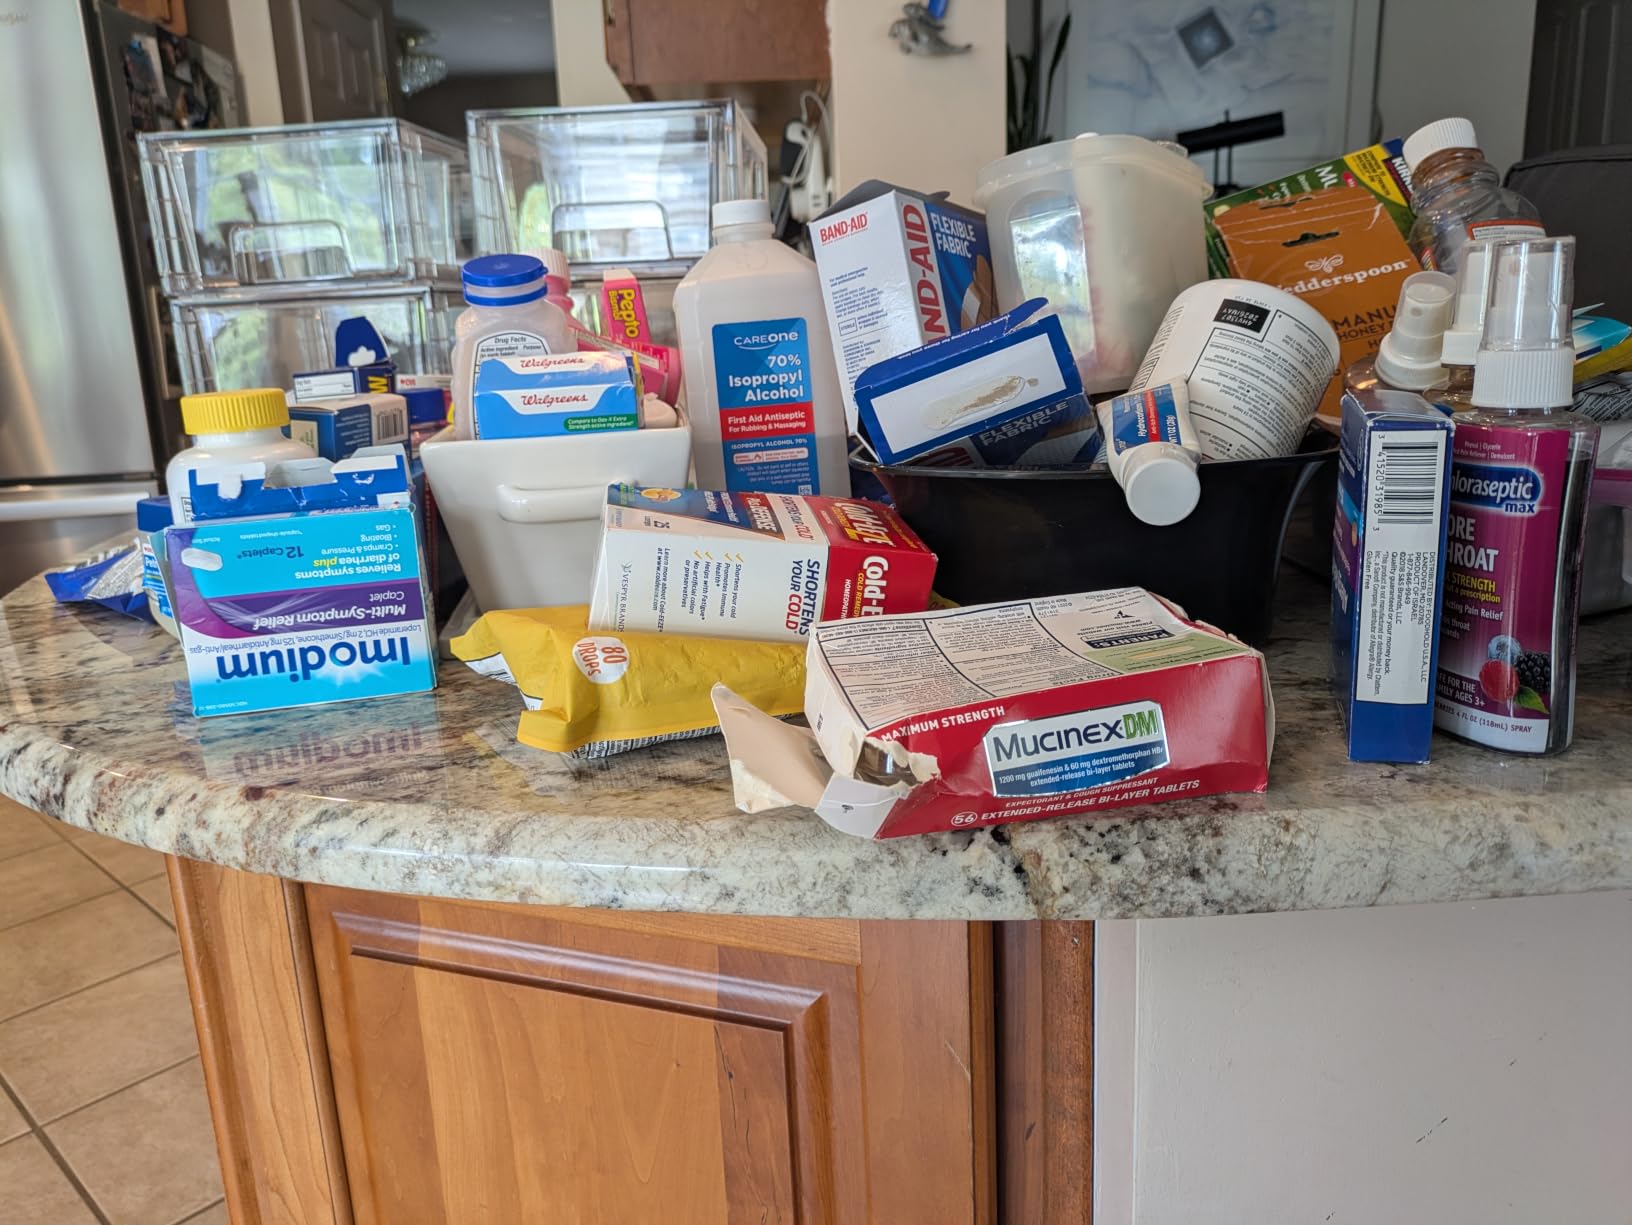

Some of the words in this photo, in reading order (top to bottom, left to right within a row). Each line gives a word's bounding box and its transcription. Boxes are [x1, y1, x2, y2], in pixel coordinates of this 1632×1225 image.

[820, 212, 868, 243] BAND-AID
[930, 213, 977, 242] FLEXIBLE
[933, 234, 972, 258] FABRIC
[619, 288, 640, 338] Pepto
[494, 336, 508, 344] Drug
[520, 357, 584, 370] Walgreens
[768, 354, 801, 368] 70%
[729, 368, 803, 388] Isopropyl
[521, 394, 588, 408] Walgreens
[745, 384, 803, 402] Alcohol
[568, 418, 590, 426] Compare
[568, 422, 590, 430] Strength
[728, 414, 746, 425] First
[748, 413, 762, 423] Aid
[764, 410, 806, 421] Antiseptic
[741, 424, 768, 433] Rubbing
[774, 421, 806, 430] Massaging
[979, 401, 1070, 441] FLEXIBLE
[732, 442, 764, 450] ISOPROPYL
[766, 440, 794, 448] ALCOHOL
[1490, 452, 1516, 460] Demulcent
[1376, 452, 1386, 480] 41520
[1374, 486, 1384, 514] 31985
[1504, 502, 1536, 514] max
[375, 523, 391, 532] Gas
[751, 504, 779, 533] DEFENSE
[359, 529, 392, 544] Bloating
[286, 544, 305, 560] 12
[321, 545, 356, 557] Pressure
[356, 544, 363, 553] &
[364, 540, 392, 553] Cramps
[313, 554, 338, 568] plus
[338, 553, 385, 567] diarrhea
[386, 551, 400, 562] of
[693, 560, 699, 569] No
[1389, 551, 1397, 574] Quality
[295, 564, 356, 580] symptoms
[356, 561, 400, 575] Relieves
[702, 561, 710, 579] Helps
[721, 562, 730, 592] Promotes
[734, 563, 742, 590] Shortens
[788, 559, 804, 592] YOUR
[1379, 565, 1387, 584] product
[1419, 551, 1428, 591] LANDOVER,
[1426, 551, 1435, 596] DISTRIBUTED
[619, 573, 629, 601] VESPYR
[652, 555, 663, 610] www.coldeeze.com
[680, 567, 690, 608] preservatives
[690, 569, 698, 596] artificial
[1404, 552, 1413, 604] 1-877-846-9949
[1452, 573, 1496, 592] STRENGTH
[370, 590, 404, 603] Caplet
[732, 591, 740, 604] your
[796, 559, 822, 636] SHORTENS
[1370, 583, 1378, 607] Company,
[1387, 575, 1396, 612] guaranteed
[1395, 587, 1403, 610] Brands,
[1412, 586, 1418, 596] OF
[1419, 592, 1425, 603] MD
[1461, 590, 1501, 604] prescription
[688, 597, 696, 614] colors
[719, 592, 727, 616] Immune
[1464, 602, 1480, 616] Pain
[1480, 608, 1504, 622] Relief
[251, 613, 294, 629] Relief
[294, 604, 408, 624] Multi-Symptom
[1377, 599, 1386, 633] manufactured
[1452, 616, 1471, 631] throat
[378, 622, 420, 636] Loperamide
[1423, 609, 1431, 647] FOODHOLD
[270, 636, 282, 645] mg
[283, 636, 296, 645] 125
[216, 636, 410, 683] Imodium
[576, 641, 602, 677] DROPS
[600, 646, 628, 664] 80
[1375, 640, 1383, 669] distributed
[1365, 662, 1374, 680] Allergy.
[1448, 676, 1460, 689] FOR
[1462, 680, 1476, 694] THE
[1454, 688, 1473, 704] AGES
[1474, 697, 1486, 708] 3+
[880, 719, 940, 743] MAXIMUM
[939, 705, 1005, 728] STRENGTH
[1462, 712, 1468, 720] FL
[1470, 714, 1478, 724] OZ
[1479, 718, 1508, 732] (118mL)
[1510, 724, 1533, 734] SPRAY
[999, 774, 1015, 784] 1200
[1015, 774, 1026, 783] mg
[1026, 765, 1064, 781] guaifenesin
[1064, 763, 1070, 771] &
[1070, 761, 1079, 770] 60
[1080, 761, 1091, 771] mg
[1091, 747, 1152, 767] dextromethorphan
[1152, 745, 1164, 754] HBr
[1029, 769, 1085, 787] extended-release
[1086, 764, 1111, 776] bi-layer
[1112, 760, 1135, 771] tablets
[954, 812, 975, 824] 56
[981, 798, 1096, 820] EXTENDED-RELEASE
[1098, 790, 1150, 806] BI-LAYER
[1152, 779, 1200, 798] TABLETS
[1005, 794, 1064, 809] EXPECTORANT
[1073, 787, 1101, 797] COUGH
[1101, 776, 1159, 792] SUPPRESSANT
